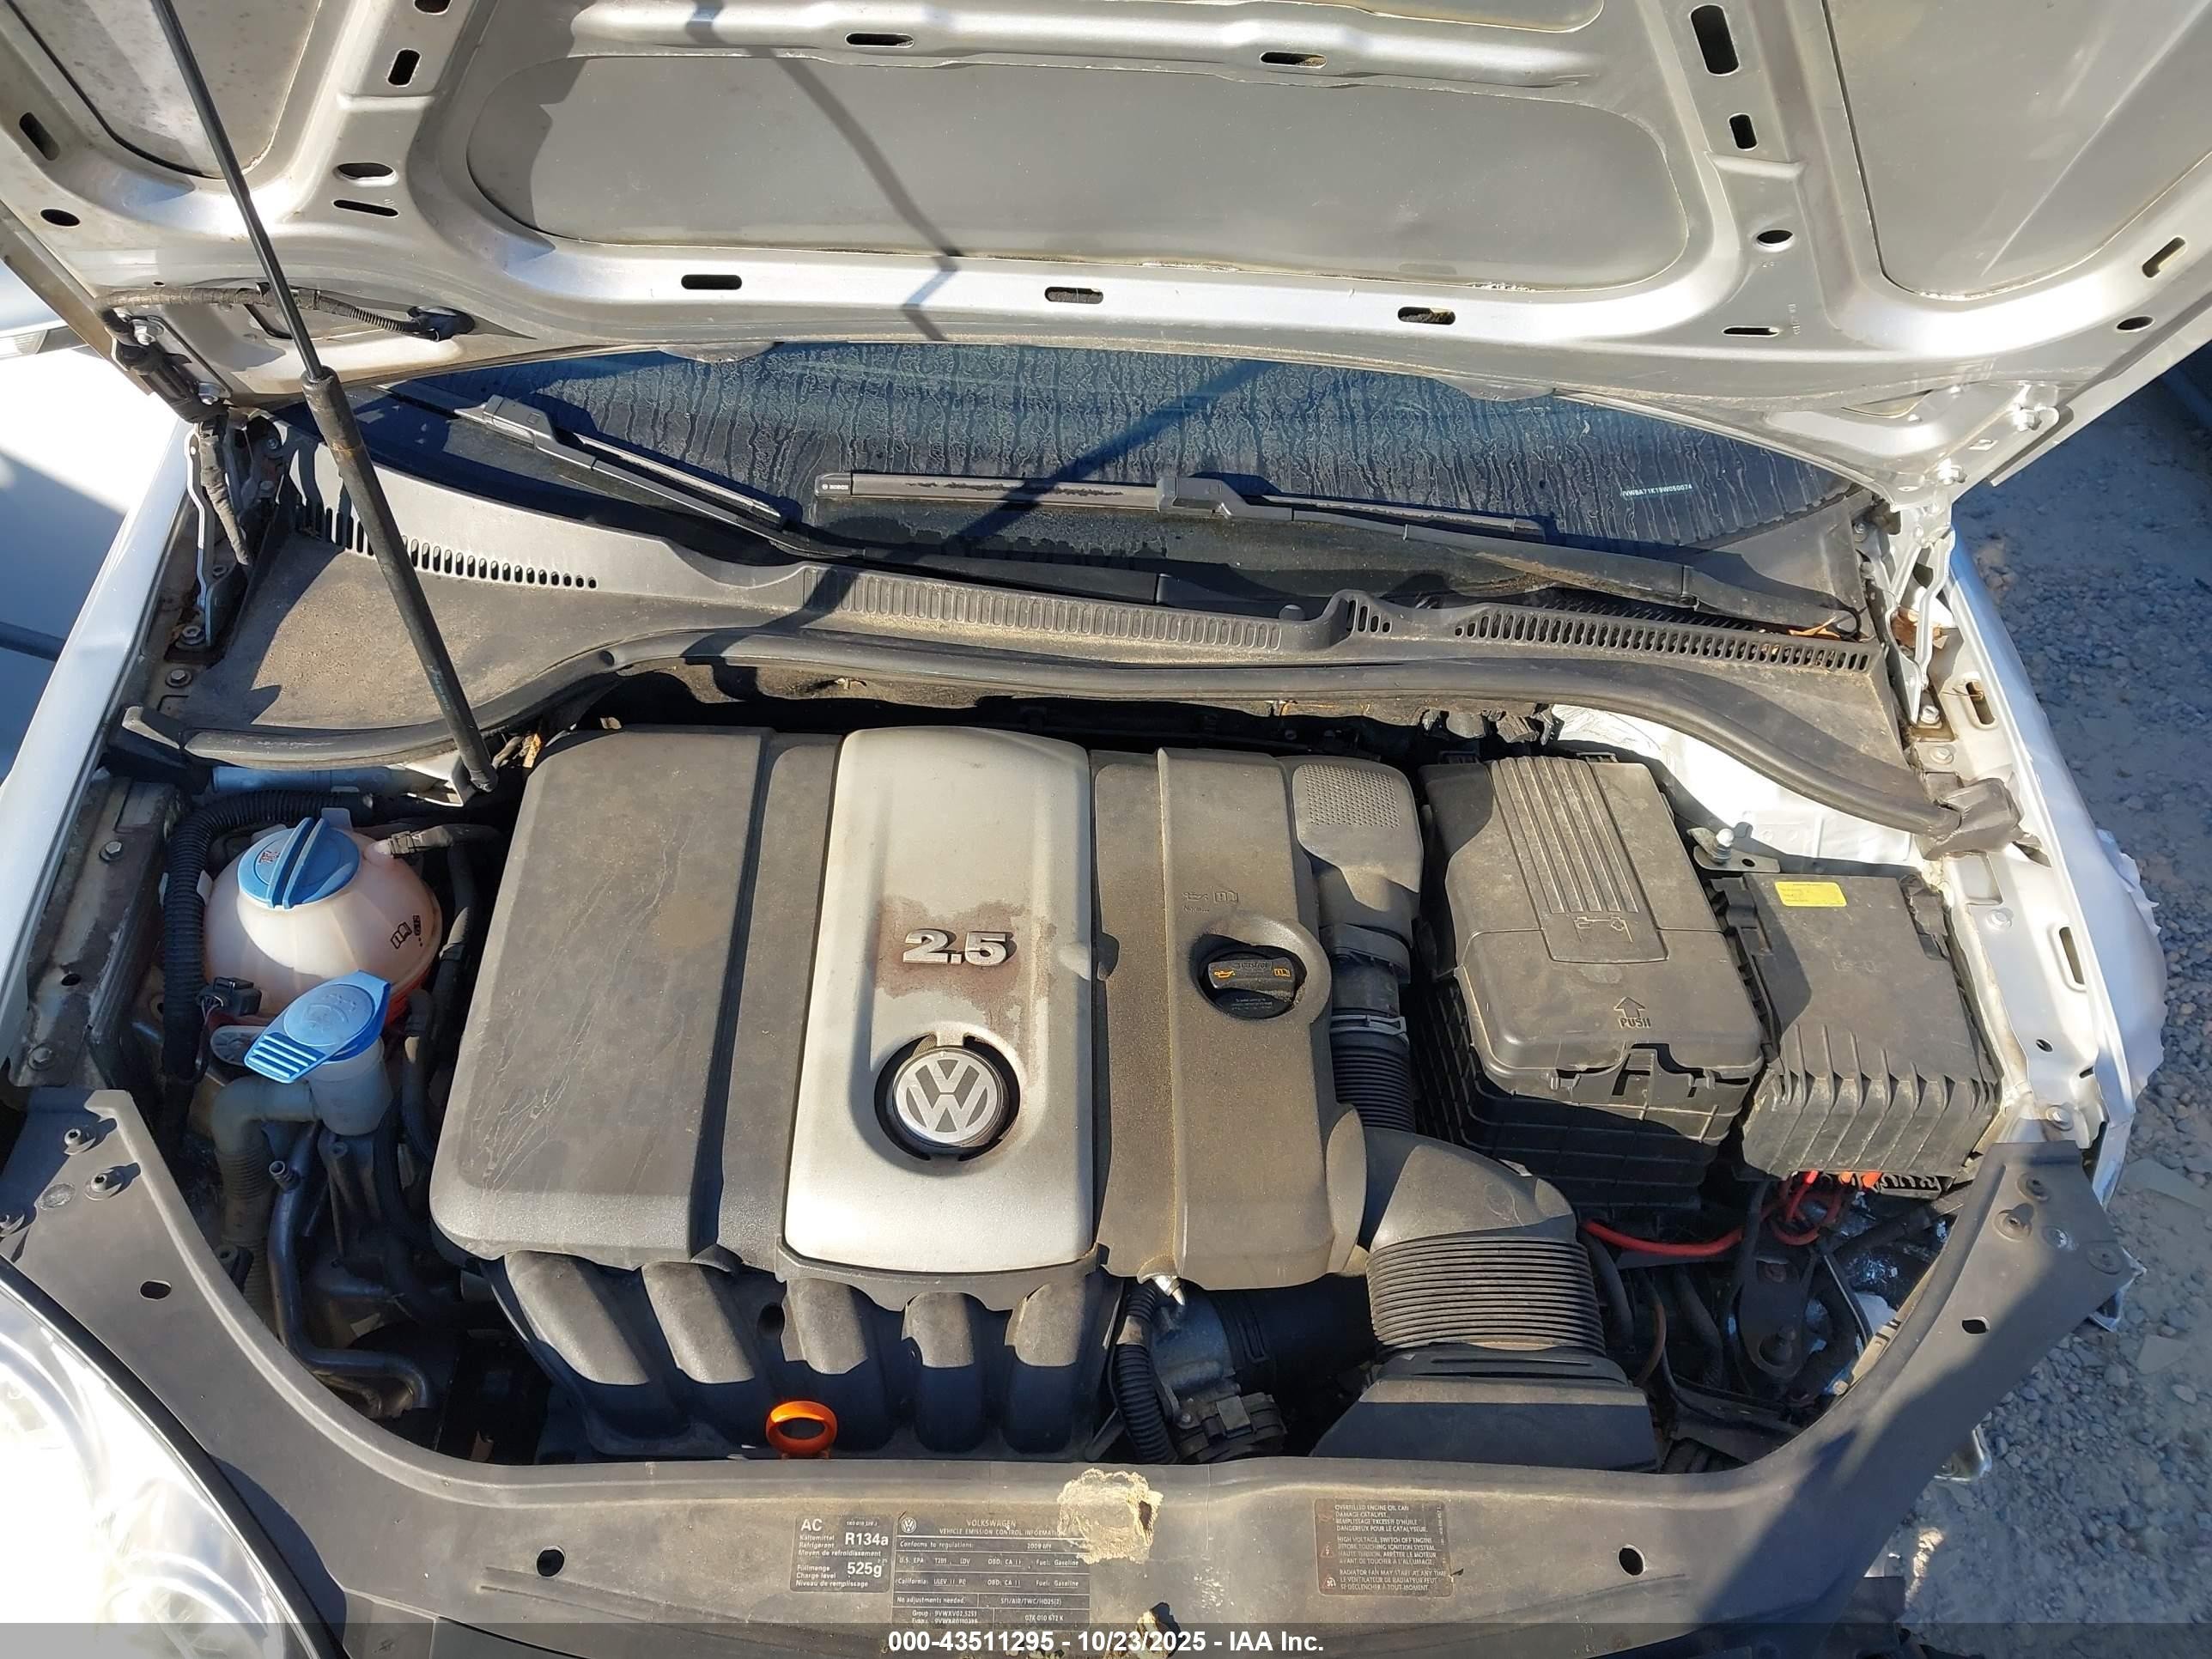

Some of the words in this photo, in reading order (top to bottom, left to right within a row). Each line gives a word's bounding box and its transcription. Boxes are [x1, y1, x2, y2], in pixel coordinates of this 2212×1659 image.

[903, 928, 1008, 966] 2.5
[1620, 1018, 1651, 1029] PUSH
[801, 1518, 823, 1531] AC
[966, 1518, 1017, 1527] VOLKSWAGEN
[845, 1532, 889, 1546] R134a
[847, 1561, 883, 1578] 525g
